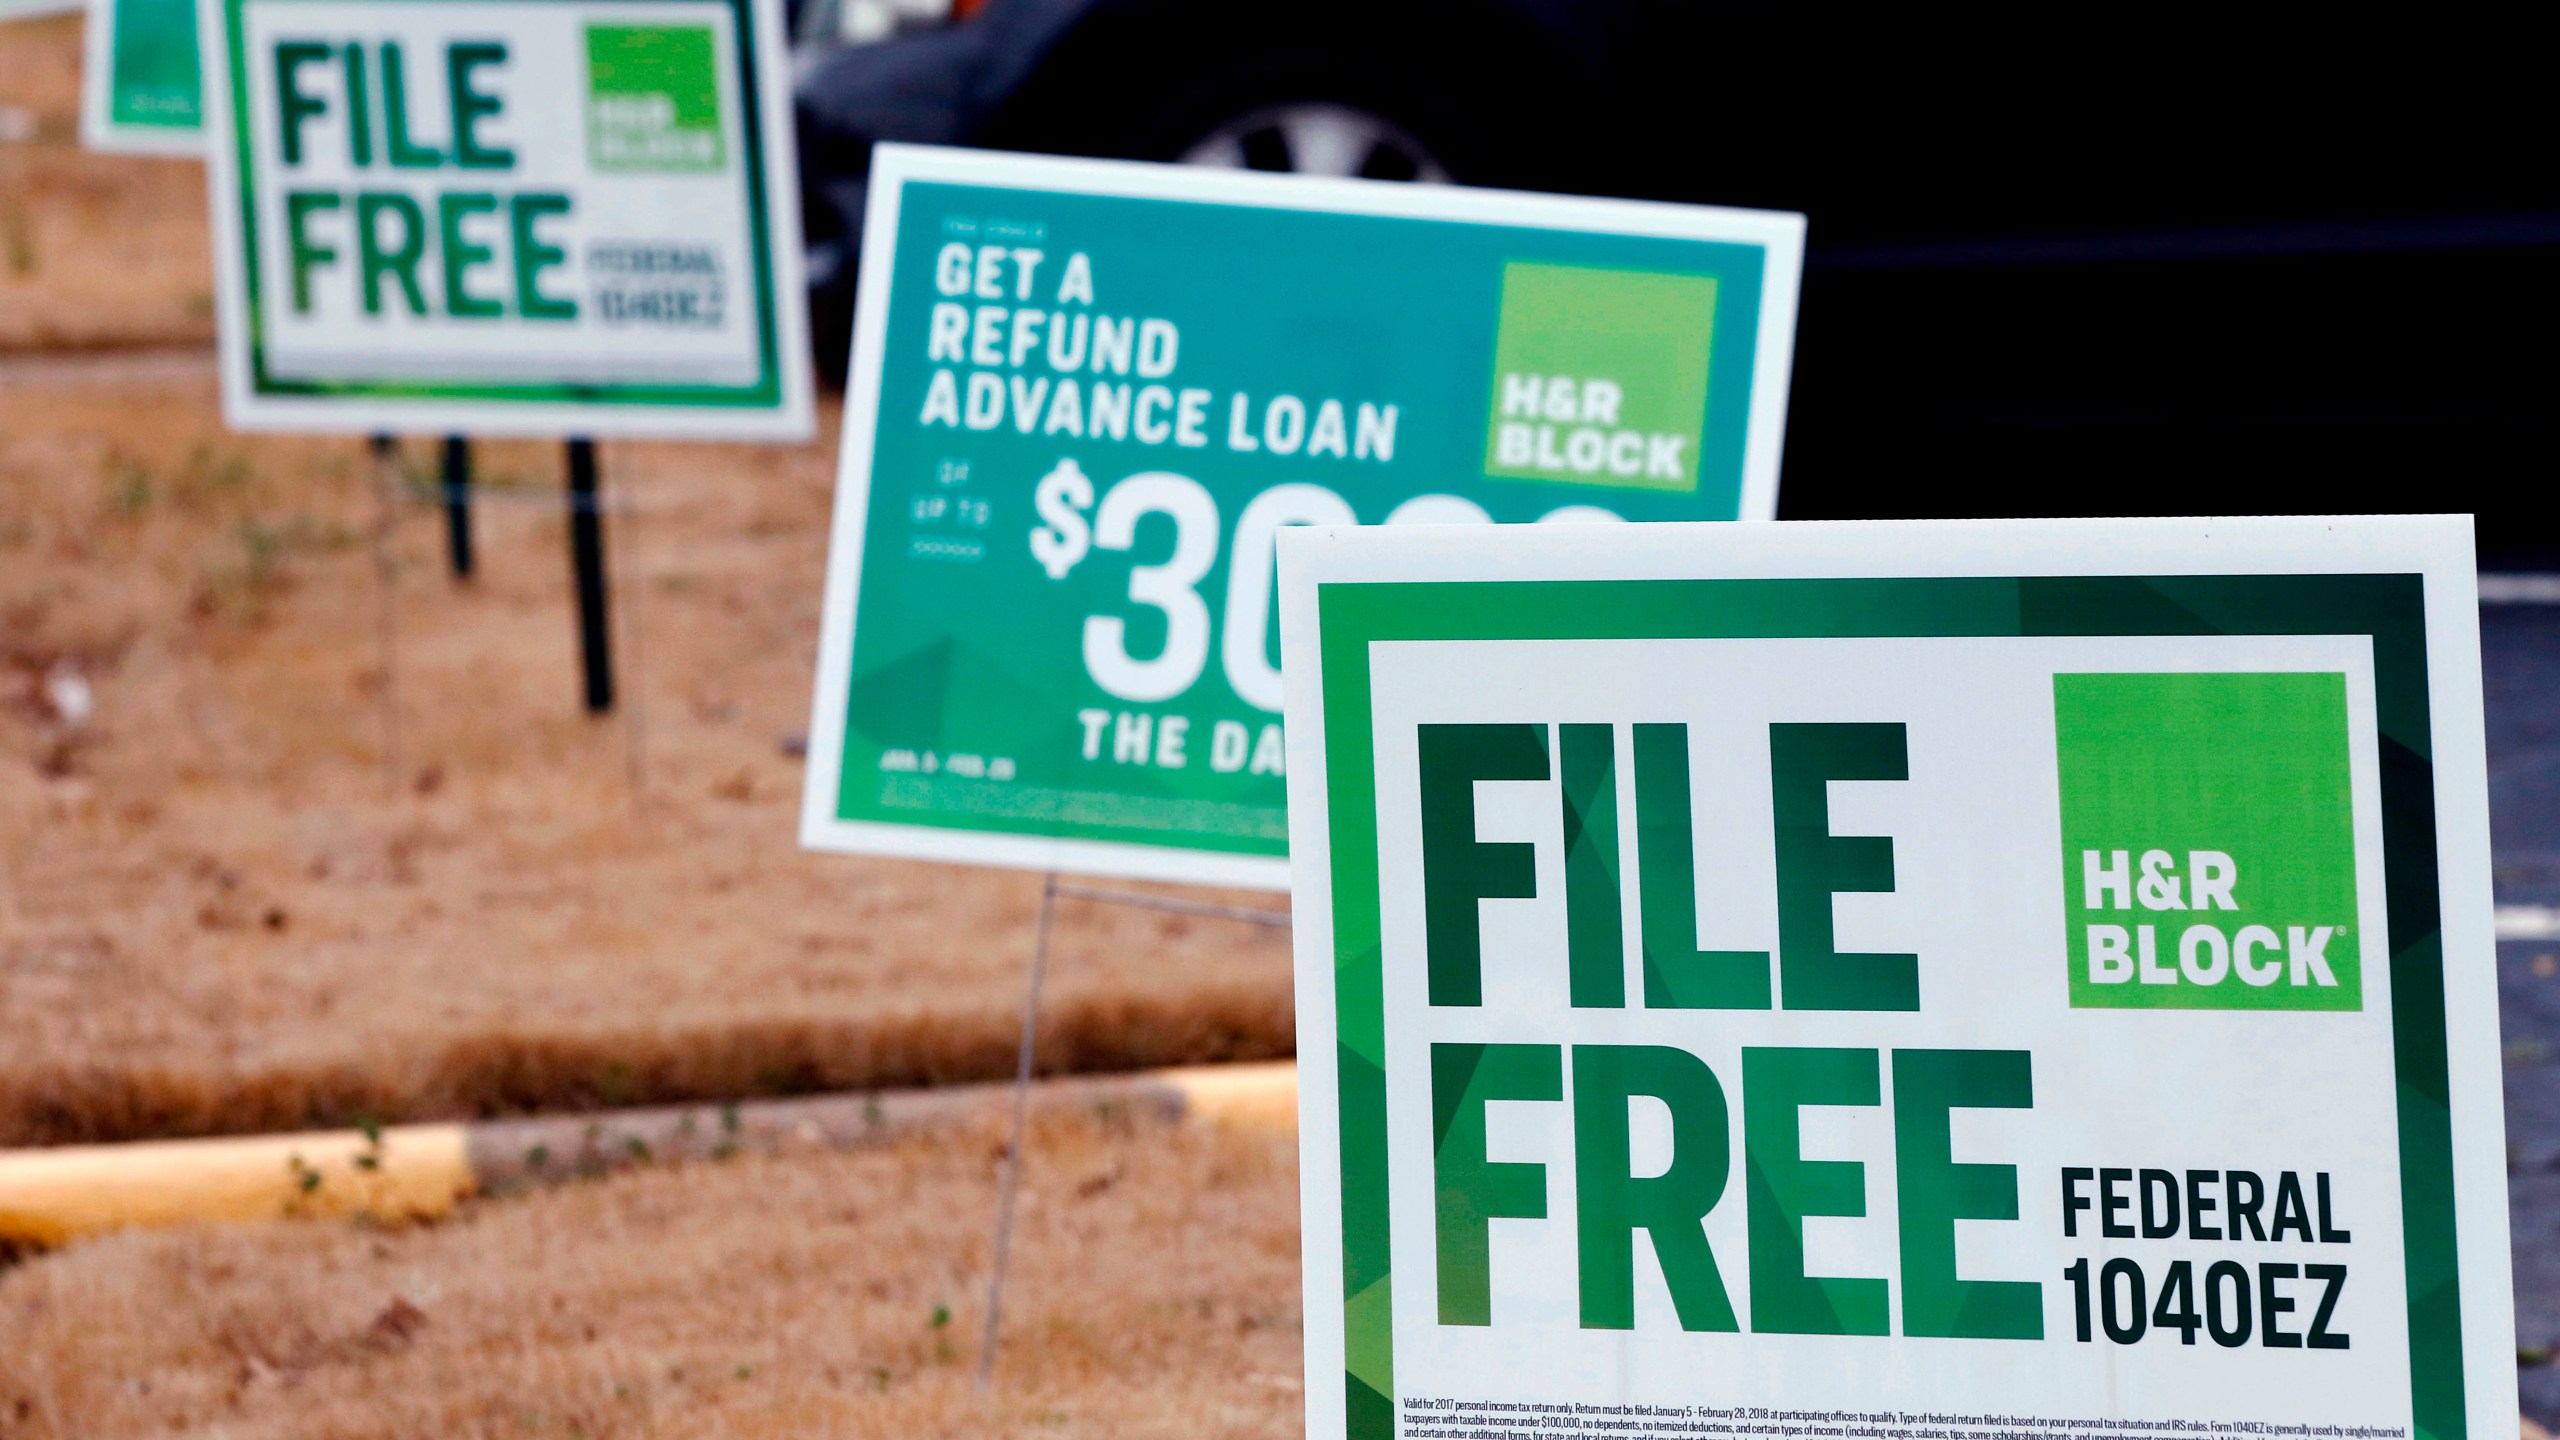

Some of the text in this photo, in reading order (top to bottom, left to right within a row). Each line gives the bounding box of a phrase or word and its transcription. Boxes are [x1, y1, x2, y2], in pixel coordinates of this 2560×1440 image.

[274, 41, 515, 169] FILE
[286, 192, 578, 320] FREE
[935, 242, 1093, 306] GET A
[927, 302, 1179, 379] REFUND
[919, 368, 1399, 462] ADVANCE LOAN
[1503, 373, 1622, 427] H&R
[1497, 422, 1686, 480] BLOCK
[1077, 708, 1190, 769] THE
[1209, 720, 1287, 776] DA
[1417, 722, 1920, 1011] FILE
[2083, 849, 2239, 911] H&R
[1430, 1043, 2044, 1340] FREE
[2061, 1167, 2351, 1243] FEDERAL
[2064, 1257, 2350, 1350] 1040EZ
[1403, 1397, 1423, 1409] Valid
[1423, 1398, 1434, 1410] for
[1435, 1398, 1454, 1410] 2017
[1455, 1399, 1488, 1414] personal
[1489, 1400, 1518, 1412] income
[1518, 1402, 1531, 1413] tax
[1532, 1402, 1555, 1413] return
[1556, 1402, 1574, 1417] only.
[1576, 1403, 1601, 1415] Return
[1602, 1404, 1622, 1415] must
[1623, 1404, 1633, 1416] be
[1635, 1404, 1652, 1416] filed
[1653, 1405, 1685, 1420] January
[1686, 1406, 1692, 1417] 5
[1698, 1406, 1734, 1421] February
[1734, 1407, 1748, 1421] 28,
[1749, 1408, 1769, 1420] 2018
[1770, 1409, 1778, 1420] at
[1780, 1409, 1830, 1424] participating
[1830, 1410, 1858, 1422] offices
[1859, 1412, 1868, 1423] to
[1869, 1411, 1898, 1426] qualify.
[1898, 1412, 1918, 1427] Type
[1919, 1413, 1927, 1424] of
[1928, 1413, 1957, 1425] federal
[1958, 1415, 1983, 1426] return
[1984, 1415, 2002, 1426] filed
[2003, 1415, 2010, 1427] is
[2011, 1415, 2035, 1427] based
[2037, 1419, 2047, 1428] on
[2048, 1419, 2066, 1431] your
[2068, 1417, 2103, 1432] personal
[2104, 1419, 2117, 1430] tax
[2118, 1419, 2154, 1431] situation
[2155, 1420, 2170, 1431] and
[2171, 1420, 2186, 1432] IRS
[2187, 1421, 2210, 1433] rules.
[2211, 1421, 2232, 1433] Form
[2233, 1422, 2265, 1434] 1040EZ
[2266, 1423, 2273, 1434] is
[2275, 1423, 2311, 1438] generally
[2312, 1424, 2333, 1436] used
[2334, 1425, 2344, 1439] by
[2345, 1425, 2405, 1440] single/married
[1404, 1413, 1441, 1427] taxpayers
[1441, 1413, 1458, 1425] with
[1460, 1414, 1487, 1426] taxable
[1488, 1415, 1517, 1427] income
[1518, 1415, 1540, 1427] under
[1541, 1416, 1582, 1432] $100,000,
[1583, 1420, 1593, 1429] no
[1594, 1418, 1642, 1433] dependents,
[1643, 1422, 1653, 1431] no
[1654, 1419, 1688, 1432] itemized
[1689, 1420, 1734, 1435] deductions,
[1736, 1422, 1751, 1434] and
[1752, 1422, 1780, 1435] certain
[1781, 1424, 1803, 1438] types
[1804, 1424, 1813, 1435] of
[1814, 1424, 1843, 1436] income
[1845, 1425, 1886, 1440] (including
[1887, 1429, 1915, 1440] wages,
[1915, 1427, 1949, 1440] salaries,
[1950, 1428, 1967, 1440] tips,
[1968, 1431, 1991, 1440] some
[1404, 1427, 1419, 1439] and
[1420, 1427, 1446, 1439] certain
[1447, 1428, 1468, 1440] other
[1468, 1429, 1506, 1440] additional
